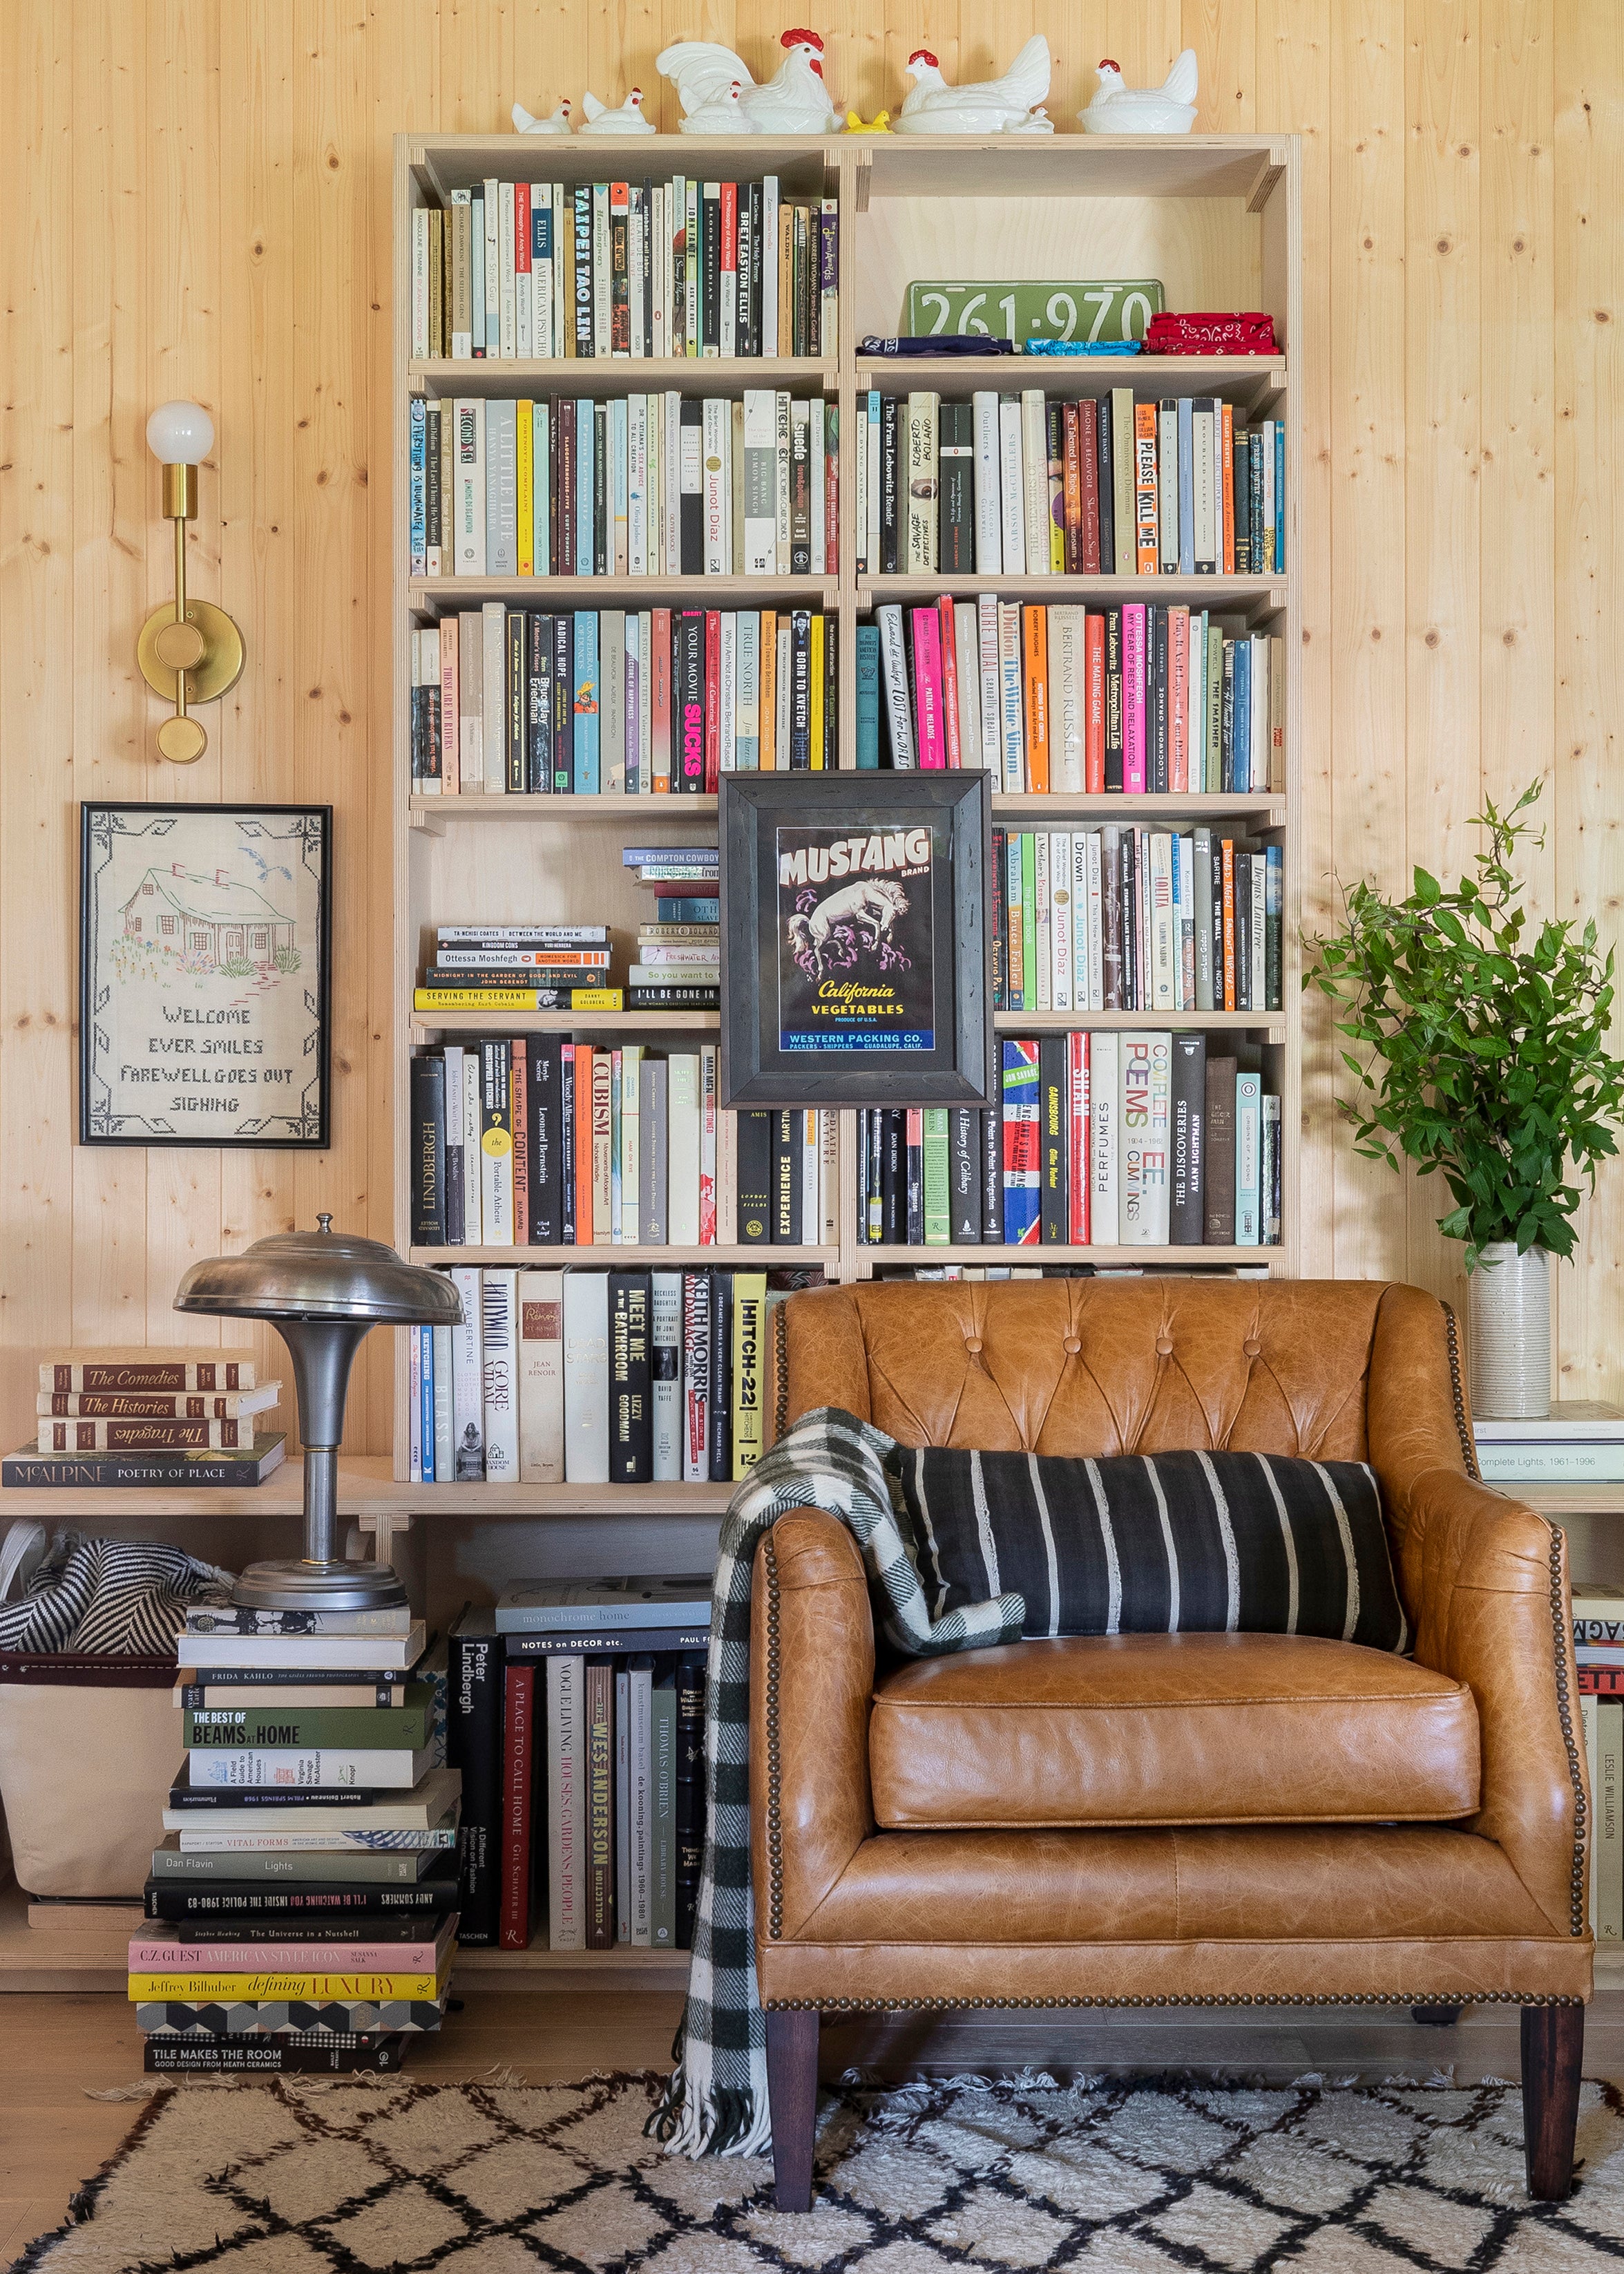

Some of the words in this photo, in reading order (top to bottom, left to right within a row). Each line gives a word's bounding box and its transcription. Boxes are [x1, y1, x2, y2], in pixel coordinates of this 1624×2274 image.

[537, 220, 546, 248] ELLIS
[575, 188, 590, 260] TAIPEI
[740, 244, 748, 288] EASTON
[537, 264, 546, 315] AMERICAN
[576, 265, 590, 302] TAO
[537, 319, 546, 356] PSYCHO
[577, 307, 591, 341] LIN
[794, 424, 807, 460] suede
[1069, 461, 1076, 471] Mr
[1140, 442, 1154, 484] PLEASE
[710, 475, 718, 509] Junot
[1138, 492, 1154, 522] KILL
[710, 515, 720, 541] Díaz
[1139, 528, 1155, 547] ME
[1127, 614, 1134, 625] MY
[557, 620, 566, 654] RADICAL
[688, 626, 698, 659] YOUR
[743, 625, 752, 657] TRUE
[557, 657, 566, 677] HOPE
[796, 652, 805, 676] BORN
[1062, 627, 1072, 694] BERTRAND
[1127, 654, 1134, 665] OF
[444, 667, 452, 690] THESE
[540, 677, 549, 704] Bruce
[688, 663, 698, 701] MOVIE
[743, 662, 752, 705] NORTH
[796, 679, 805, 690] TO
[444, 694, 452, 708] ARE
[444, 710, 452, 720] MY
[529, 677, 539, 724] Friedman
[539, 708, 550, 724] Jay
[796, 694, 805, 728] KVETCH
[444, 723, 452, 750] RIVERS
[684, 704, 701, 776] SUCKS
[1064, 699, 1074, 766] RUSSELL
[779, 828, 930, 887] MUSTANG
[901, 866, 930, 877] BRAND
[1076, 842, 1084, 882] Drown
[1010, 850, 1020, 902] Abraham
[1011, 911, 1020, 944] Bruce
[446, 954, 477, 963] Ottessa
[479, 954, 517, 964] Moshfegh
[1011, 951, 1020, 985] Feiler
[427, 992, 464, 1000] SERVING
[469, 992, 485, 1000] THE
[488, 992, 526, 1000] SERVANT
[661, 989, 672, 999] BE
[676, 989, 700, 999] GONE
[705, 990, 714, 998] IN
[819, 980, 895, 1004] California
[162, 1005, 251, 1025] WELCOME
[812, 1005, 904, 1015] VEGETABLES
[149, 1039, 197, 1054] EVER
[200, 1039, 263, 1054] SMILES
[904, 1034, 923, 1043] CO.
[121, 1065, 213, 1083] FAREWELL
[214, 1069, 258, 1083] GOES
[264, 1068, 294, 1084] OUT
[1125, 1043, 1152, 1128] POEMS
[170, 1097, 240, 1112] SIGHING
[593, 1062, 609, 1136] CUBISM
[539, 1108, 548, 1141] Leonard
[1176, 1101, 1187, 1180] DISCOVERIES
[515, 1132, 526, 1192] CONTENT
[539, 1144, 548, 1184] Bernstein
[1099, 1103, 1108, 1192] PERFUMES
[423, 1122, 435, 1210] LINDBERGH
[780, 1157, 790, 1235] EXPERIENCE
[1127, 1150, 1140, 1221] CUMMINGS
[1176, 1182, 1185, 1206] THE
[629, 1289, 645, 1332] MEET
[694, 1275, 708, 1328] KEITH
[615, 1312, 628, 1381] BATHROOM
[630, 1338, 645, 1362] ME
[743, 1305, 756, 1405] HITCH-22
[90, 1371, 117, 1385] The
[117, 1370, 180, 1385] Comedies
[694, 1330, 709, 1404] MORRIS
[115, 1426, 175, 1443] Tragedies
[179, 1428, 204, 1441] The
[15, 1466, 108, 1482] McALPINE
[118, 1469, 163, 1478] POETRY
[169, 1469, 184, 1478] OF
[189, 1469, 225, 1478] PLACE
[1518, 1457, 1546, 1467] Lights,
[522, 1640, 553, 1649] NOTES
[570, 1639, 603, 1648] DECOR
[606, 1639, 623, 1647] etc.
[459, 1643, 475, 1714] Lindbergh
[475, 1643, 488, 1682] Peter
[193, 1712, 211, 1724] THE
[211, 1712, 233, 1724] BEST
[233, 1712, 246, 1723] OF
[193, 1726, 246, 1744] BEAMS
[256, 1726, 300, 1744] HOME
[591, 1723, 608, 1763] WES
[1605, 1754, 1615, 1783] LESLIE
[591, 1768, 609, 1866] ANDERSON
[1605, 1784, 1615, 1839] WILLIAMSON
[166, 1858, 184, 1868] Dan
[186, 1858, 213, 1868] Flavin
[265, 1861, 294, 1872] Lights
[148, 1981, 184, 1996] Jeffrey
[189, 1980, 236, 1992] Bilhuber
[248, 1976, 306, 1996] defining
[311, 1978, 395, 1994] LUXURY
[153, 2050, 177, 2059] TILE
[180, 2050, 218, 2059] MAKES
[221, 2050, 243, 2059] THE
[247, 2049, 282, 2059] ROOM
